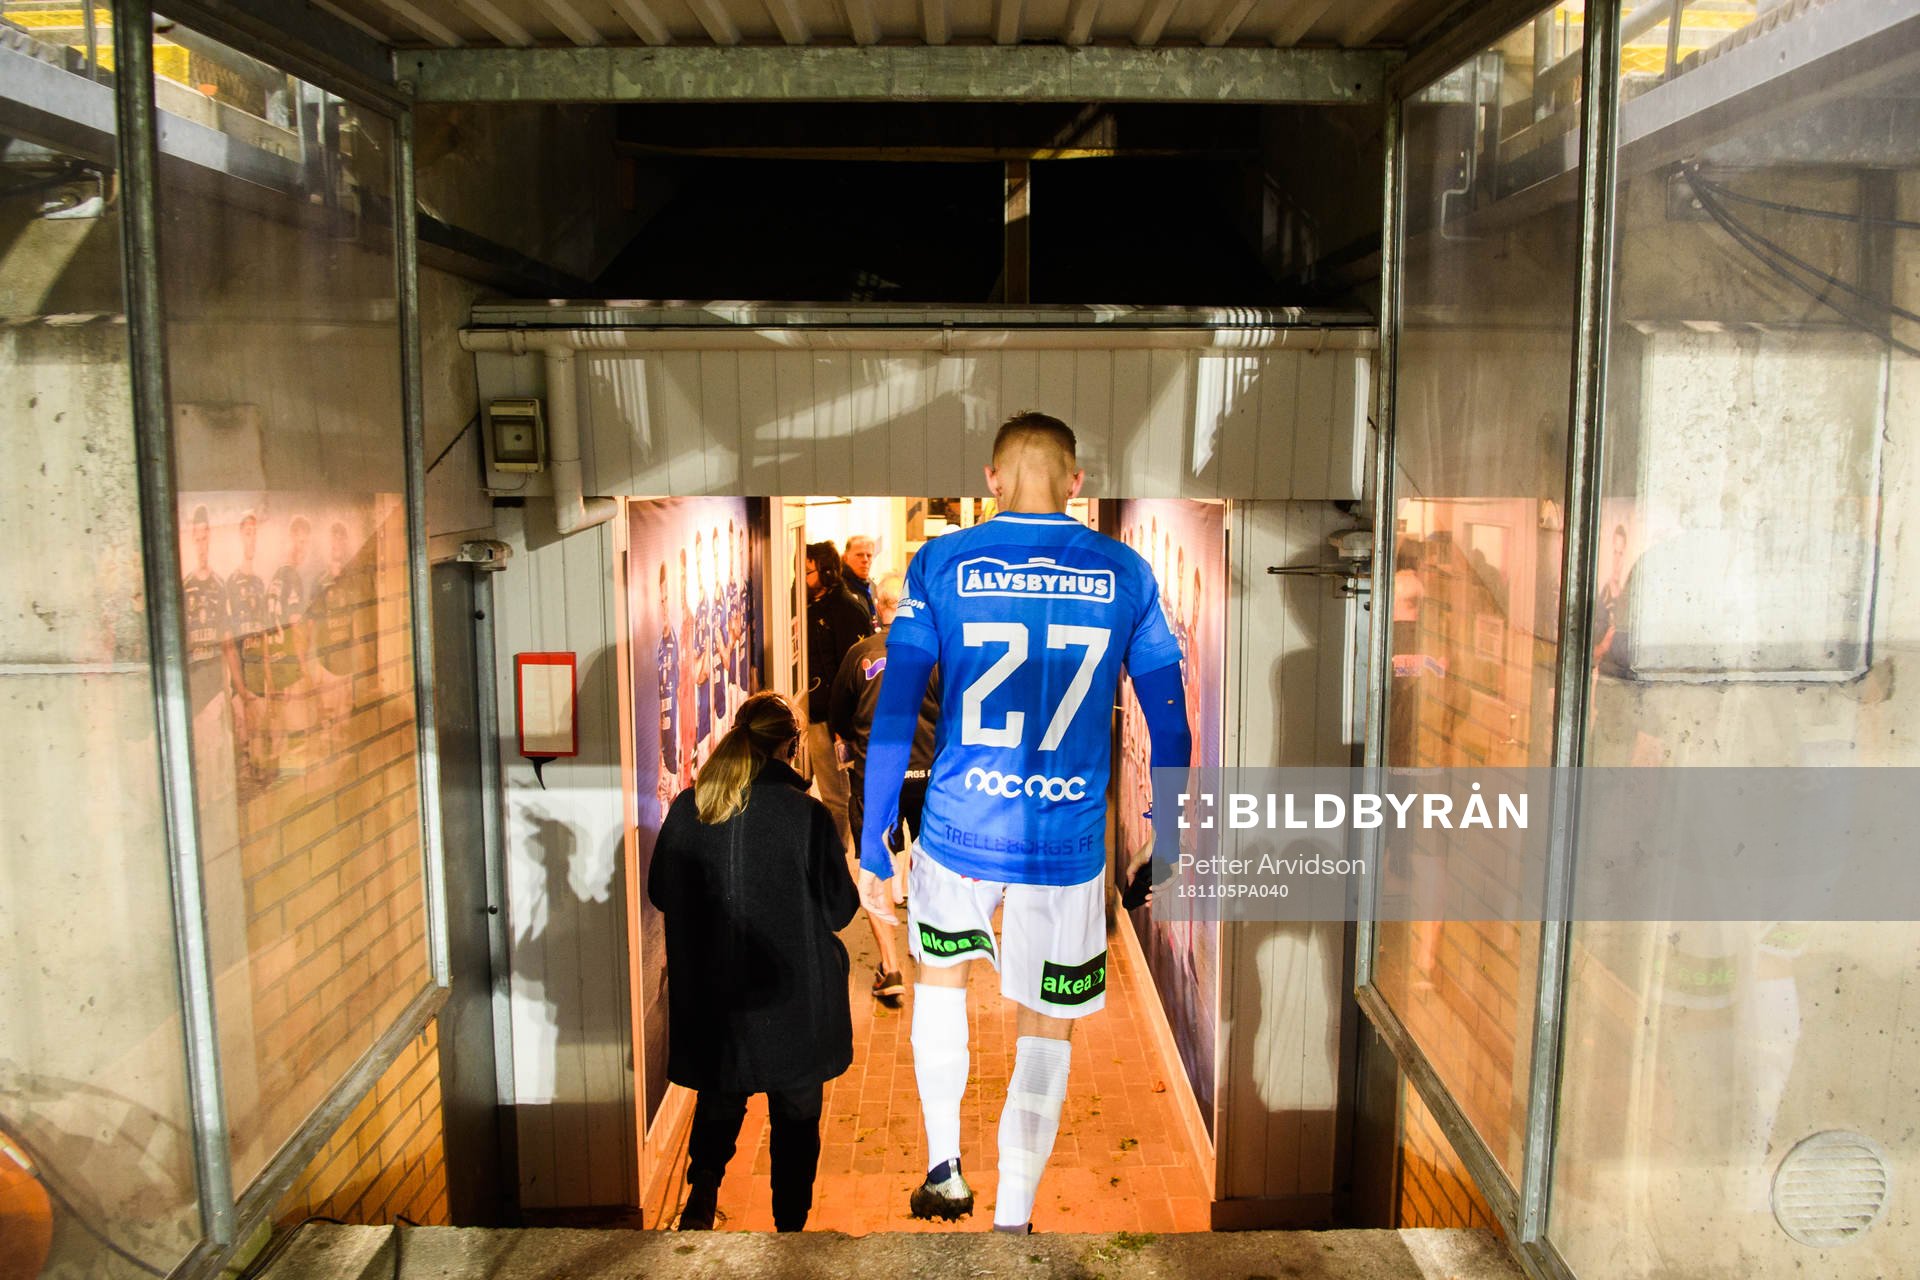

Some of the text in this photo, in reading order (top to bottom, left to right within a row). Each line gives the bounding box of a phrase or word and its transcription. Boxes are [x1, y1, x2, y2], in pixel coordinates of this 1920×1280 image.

[964, 569, 1109, 596] ÄLVSBYHUS
[961, 622, 1112, 752] 27
[945, 824, 1094, 856] TRELLEBORGS FF
[922, 931, 972, 952] akea
[1043, 974, 1092, 995] akea
